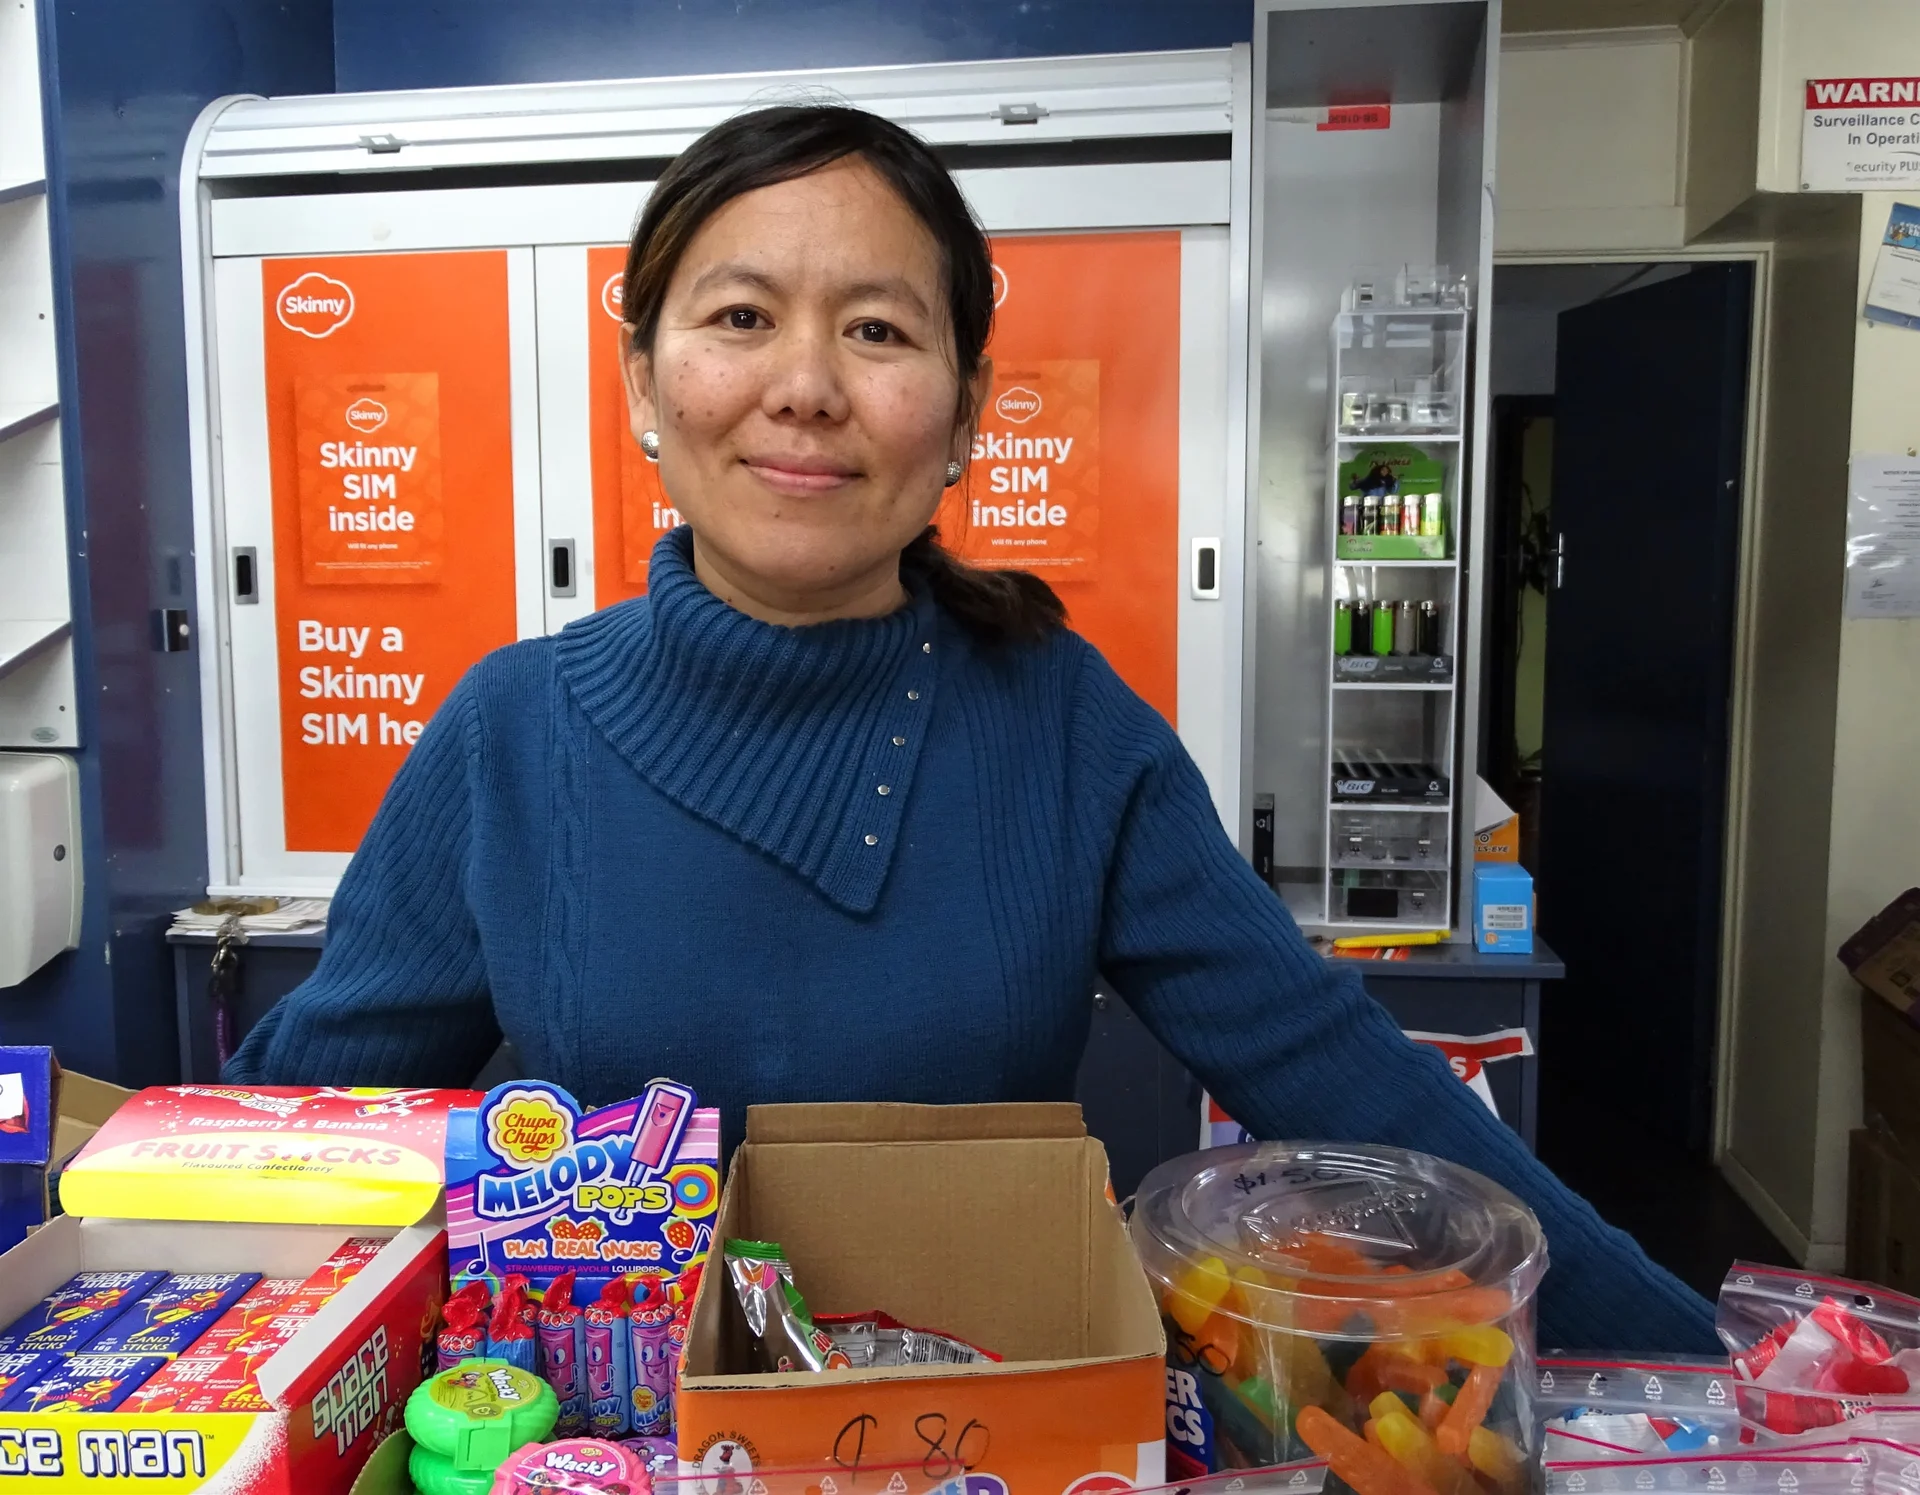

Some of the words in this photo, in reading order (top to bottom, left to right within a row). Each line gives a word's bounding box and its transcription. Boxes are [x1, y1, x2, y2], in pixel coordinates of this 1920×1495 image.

[1813, 114, 1905, 128] Surveillance
[1848, 133, 1860, 145] In
[285, 296, 345, 316] Skinny
[350, 408, 383, 423] Skinny
[1001, 399, 1036, 413] Skinny
[320, 441, 418, 472] Skinny
[970, 432, 1073, 464] Skinny
[343, 474, 396, 500] SIM
[990, 467, 1048, 493] SIM
[328, 504, 414, 532] inside
[971, 500, 1067, 528] inside
[378, 542, 398, 551] phone
[991, 538, 1005, 546] Will
[1026, 539, 1048, 547] phone
[298, 620, 370, 658] Buy
[380, 626, 404, 653] a
[299, 667, 425, 706] Skinny
[301, 713, 366, 746] SIM
[379, 712, 428, 746] he
[188, 1116, 291, 1131] Raspberry
[292, 1119, 307, 1129] &
[312, 1119, 389, 1131] Banana
[504, 1112, 558, 1130] Chupa
[130, 1141, 250, 1160] FRUIT
[502, 1127, 556, 1153] Chups
[182, 1161, 243, 1171] Flavoured
[247, 1163, 334, 1174] Confectionery
[482, 1138, 636, 1214] MELODY
[577, 1185, 667, 1209] POPS
[503, 1240, 547, 1259] PLAY
[552, 1240, 599, 1259] REAL
[602, 1241, 662, 1260] MUSIC
[505, 1264, 566, 1272] STRAWBERRY
[612, 1265, 661, 1273] LOLLIPOPS
[15, 1342, 67, 1351] STICKS
[24, 1334, 78, 1343] CANDY
[119, 1343, 170, 1351] STICKS
[486, 1367, 522, 1401] Wacky
[692, 1430, 726, 1469] DRAGON
[729, 1430, 762, 1468] SWEETS
[914, 1412, 991, 1481] 80
[545, 1451, 617, 1477] Wacky
